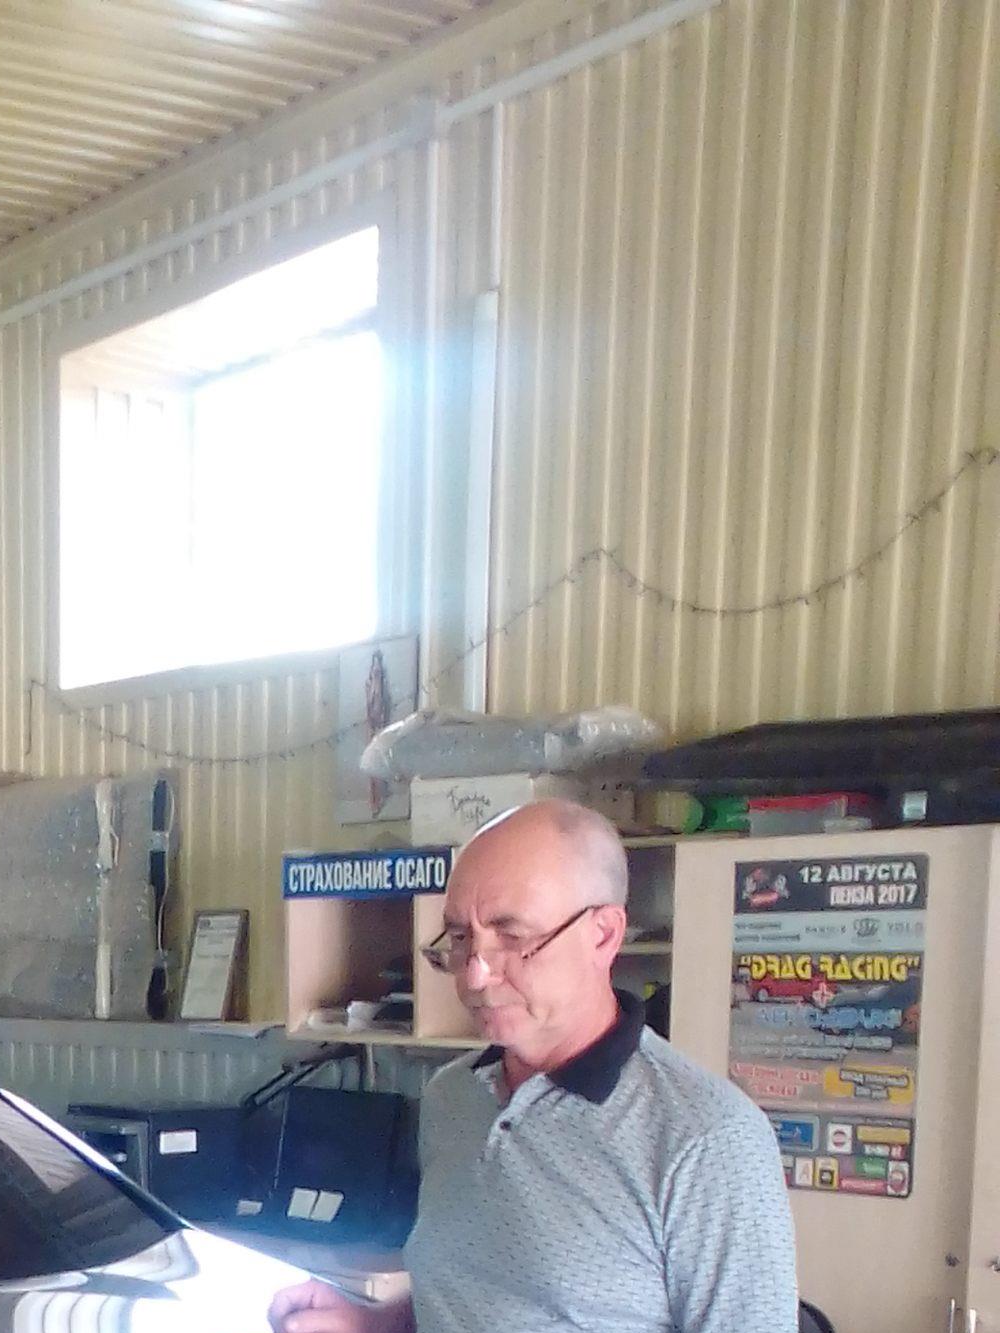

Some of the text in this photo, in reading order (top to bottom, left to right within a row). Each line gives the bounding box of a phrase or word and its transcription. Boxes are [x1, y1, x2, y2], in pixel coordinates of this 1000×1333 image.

[289, 857, 446, 893] СТРАХОВАНИЕ ОСАГО
[799, 862, 917, 883] 12 АВГУСТА
[830, 884, 918, 906] ПЕНЗА 2017
